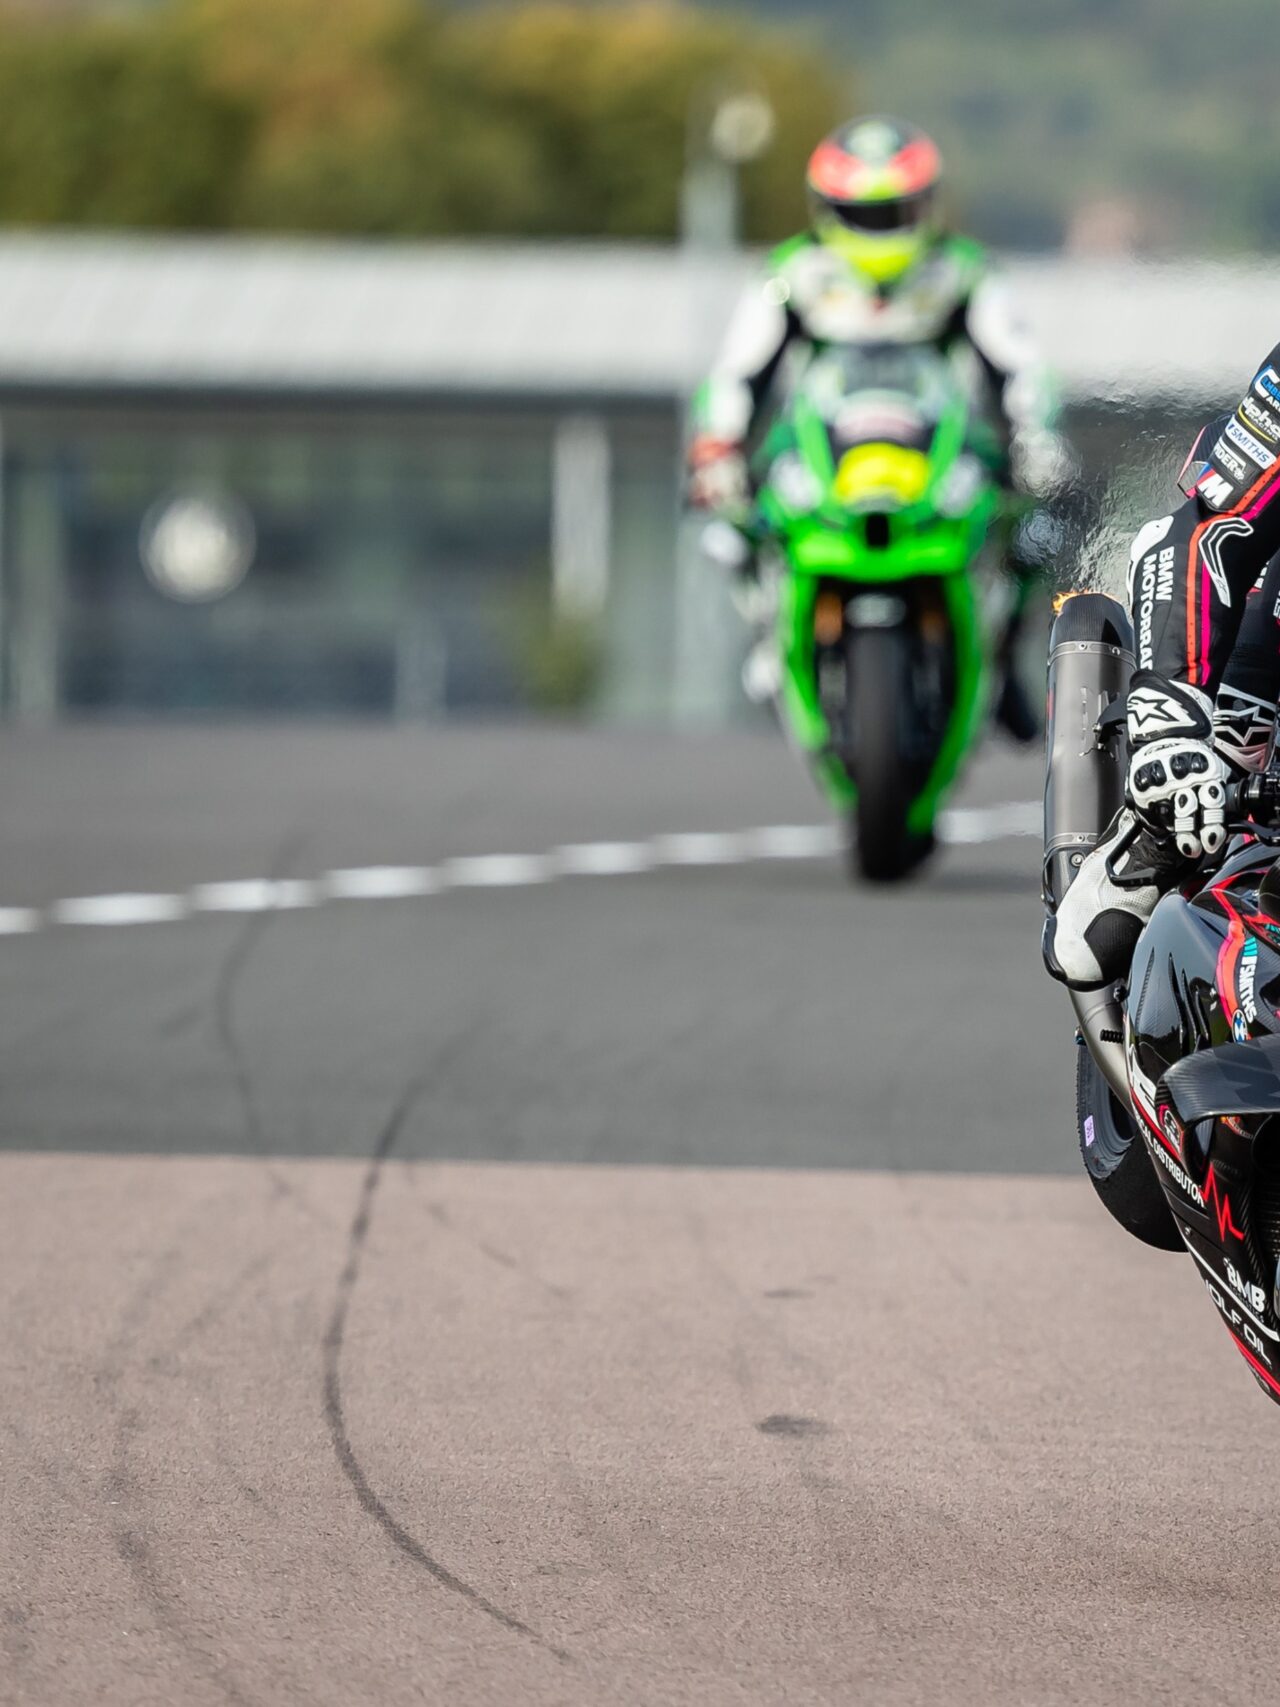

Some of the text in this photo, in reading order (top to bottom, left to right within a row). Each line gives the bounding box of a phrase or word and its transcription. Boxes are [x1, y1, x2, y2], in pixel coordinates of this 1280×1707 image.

[1231, 428, 1270, 463] SMITHS
[1155, 546, 1175, 601] BMW
[1227, 1265, 1266, 1313] BMB
[1244, 1324, 1273, 1366] OIL
